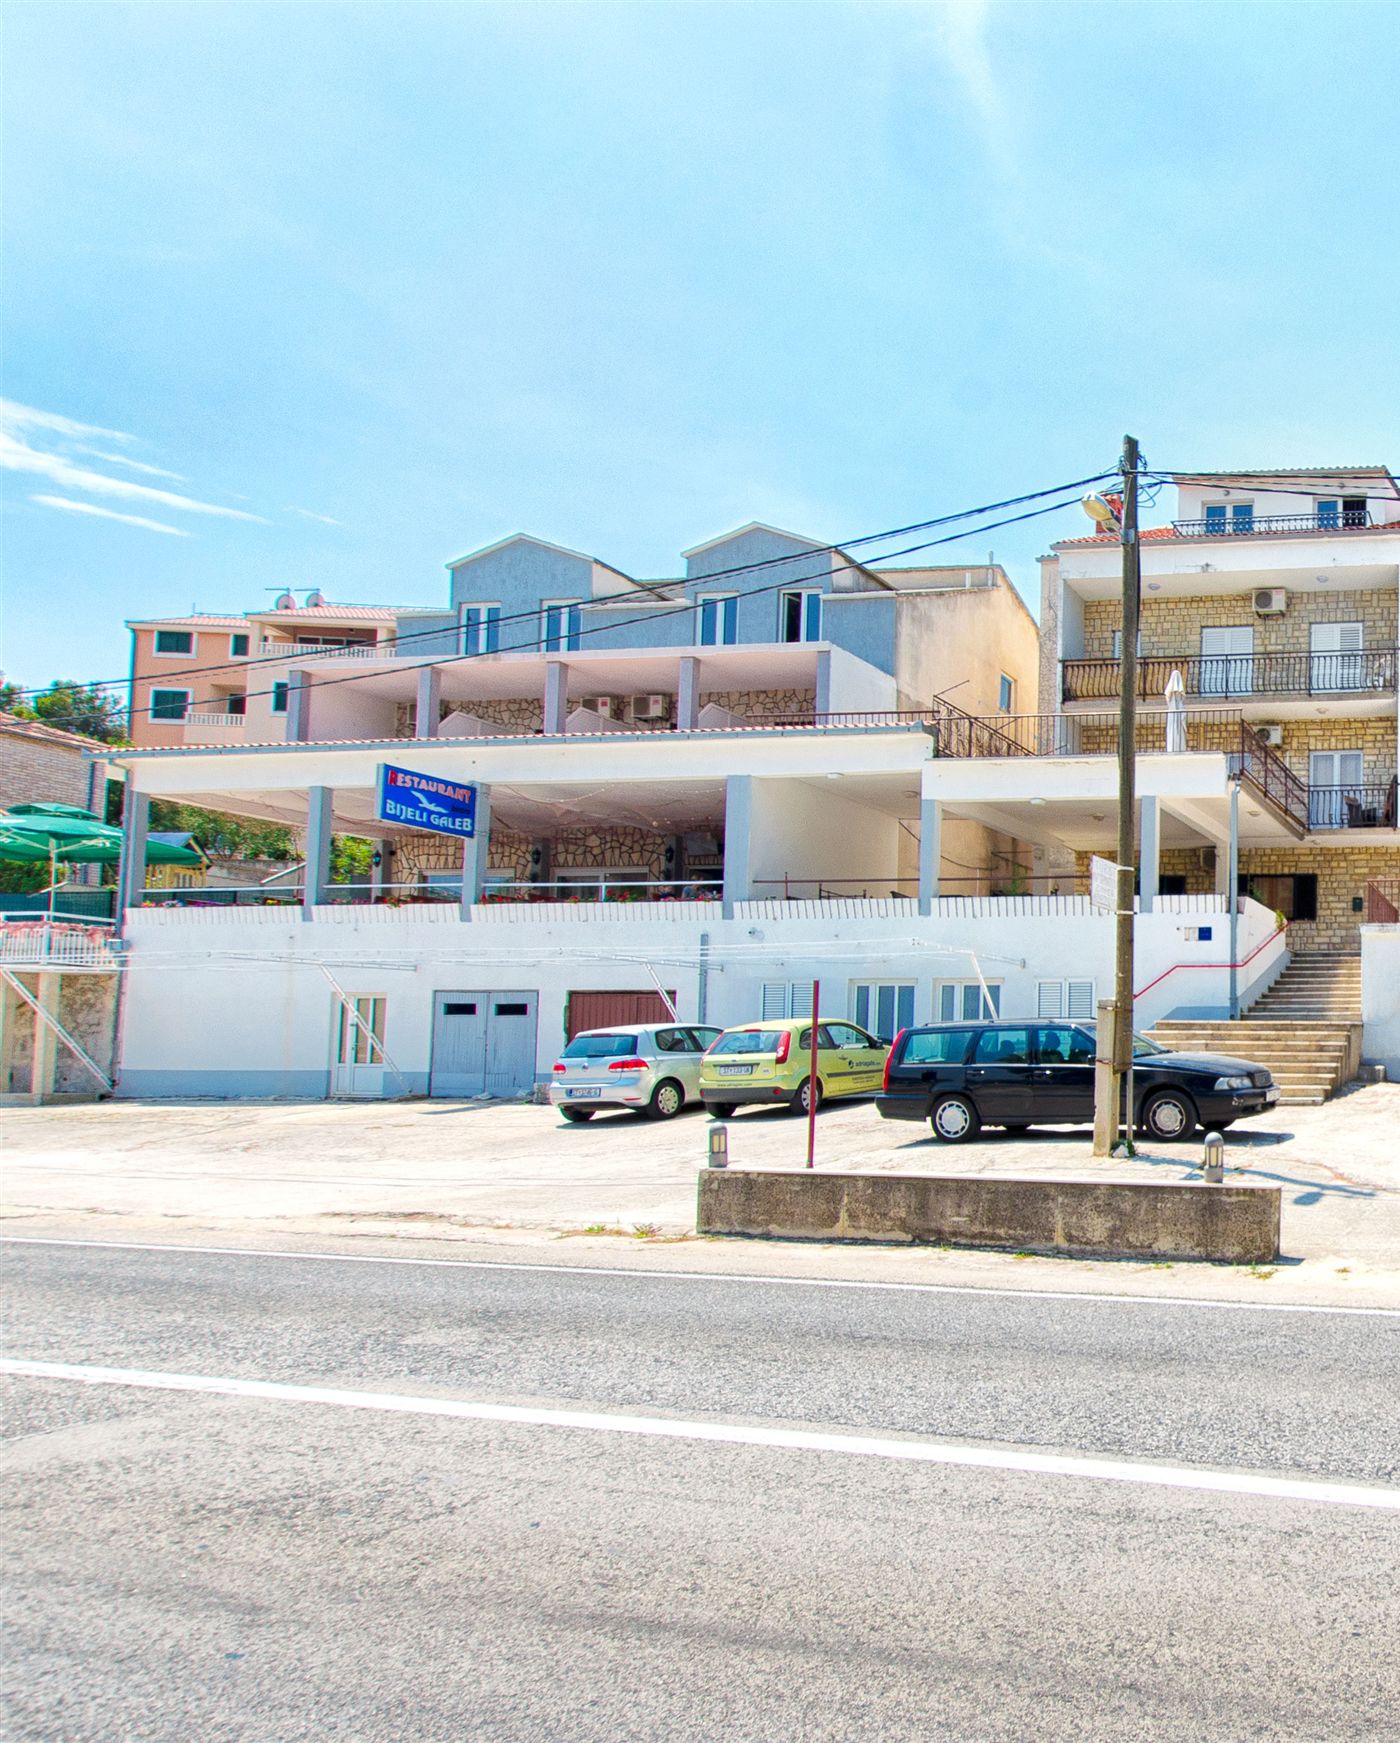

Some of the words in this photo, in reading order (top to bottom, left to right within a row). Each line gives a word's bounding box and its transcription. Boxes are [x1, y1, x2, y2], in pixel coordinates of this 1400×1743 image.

[388, 769, 471, 804] RESTAURANT
[385, 799, 428, 822] BIJELI
[430, 814, 473, 831] GALEB
